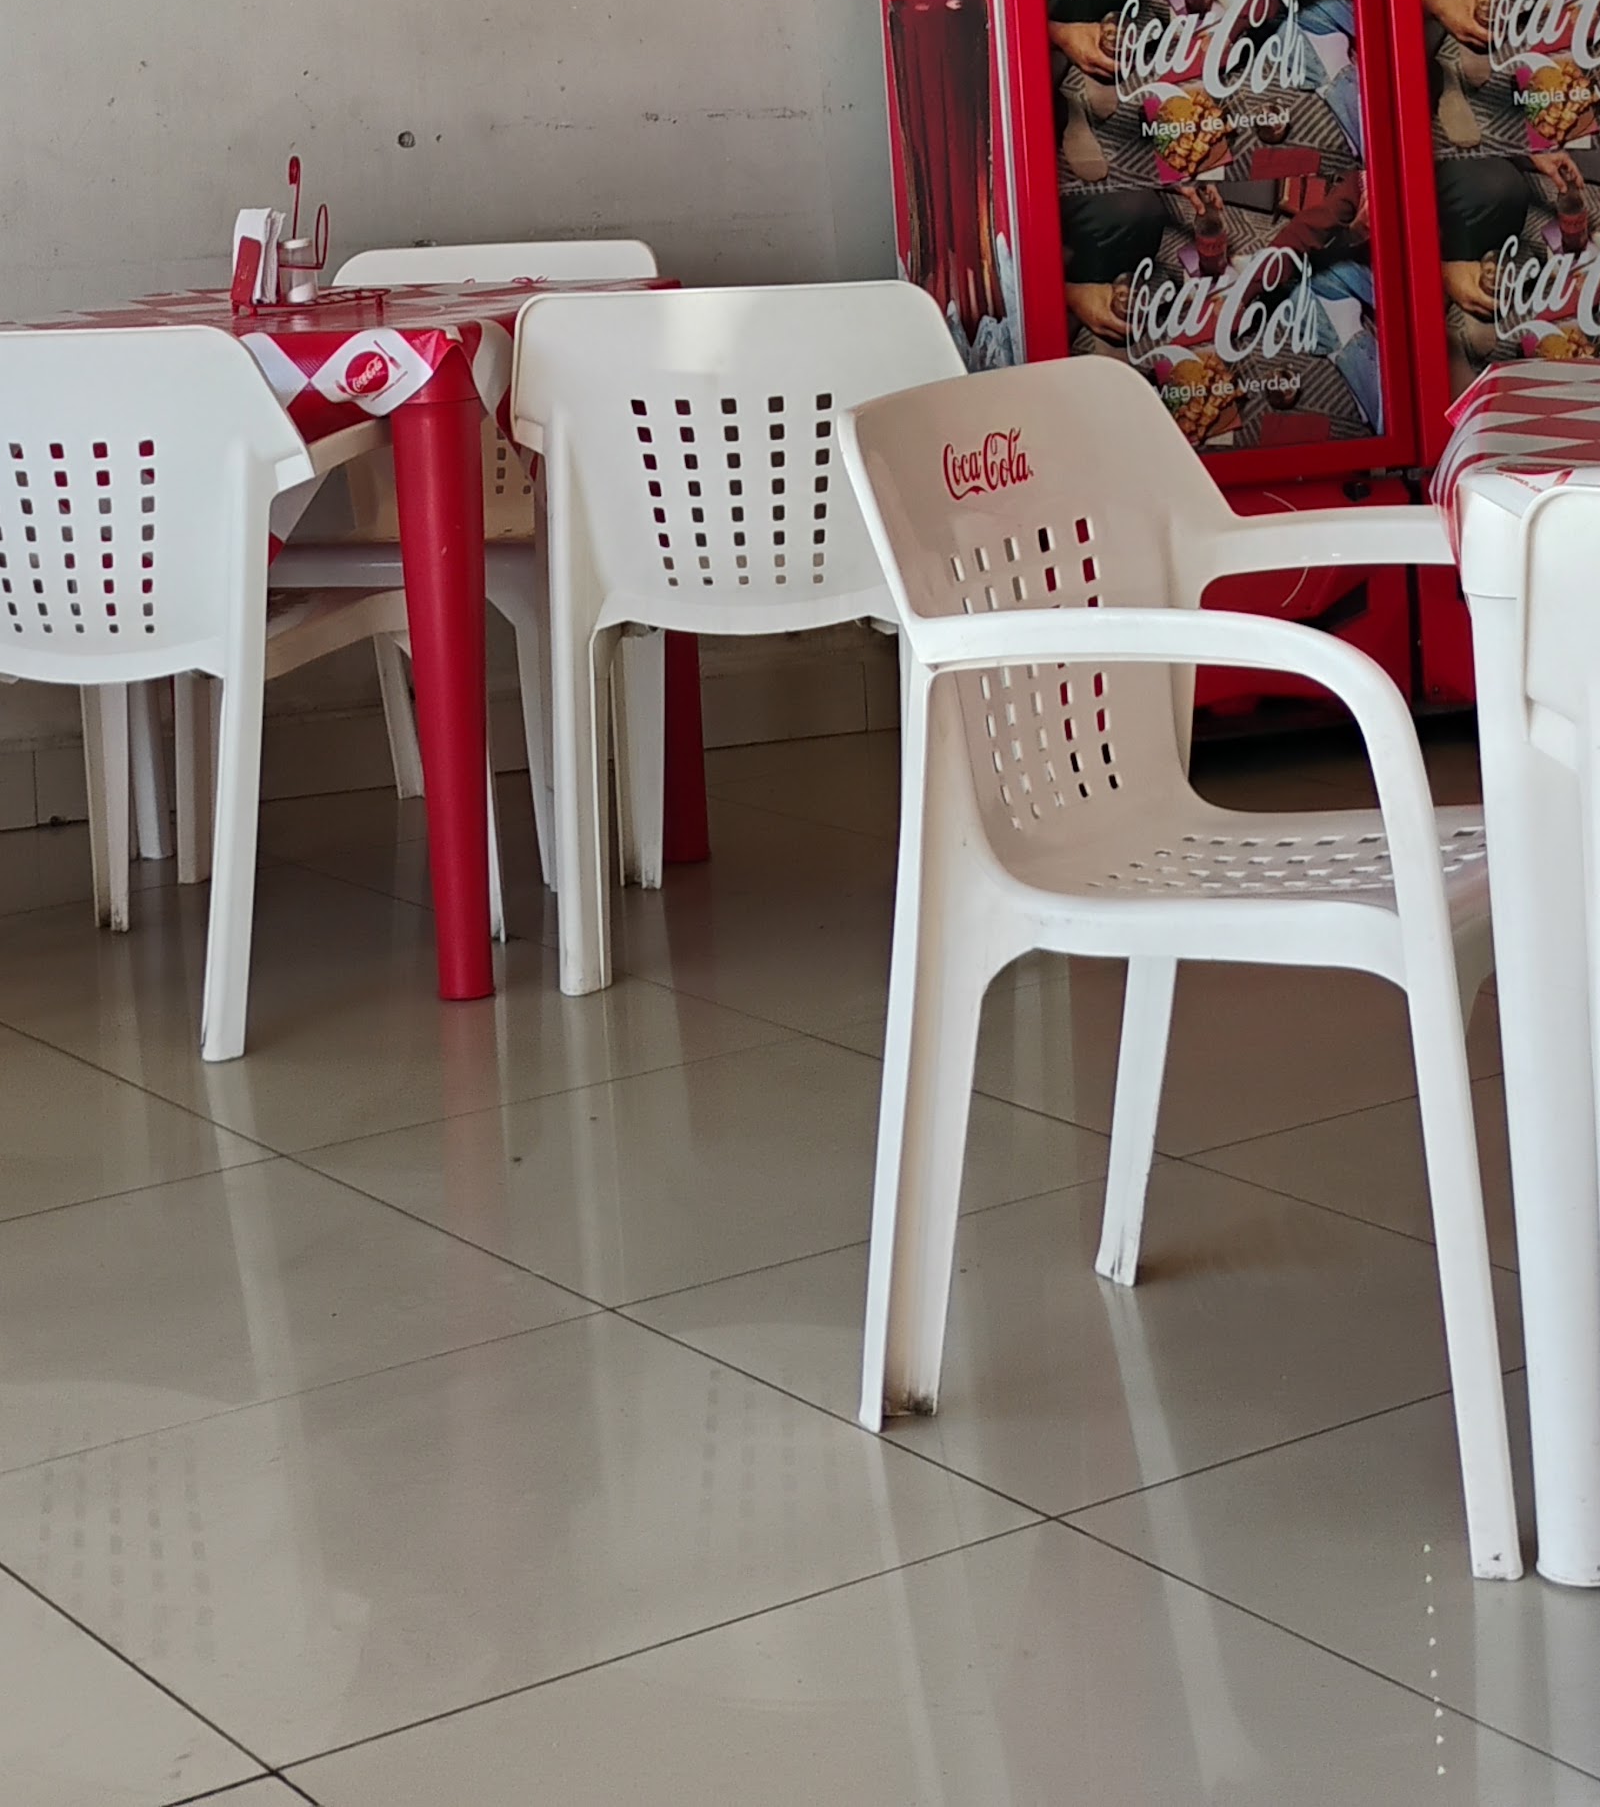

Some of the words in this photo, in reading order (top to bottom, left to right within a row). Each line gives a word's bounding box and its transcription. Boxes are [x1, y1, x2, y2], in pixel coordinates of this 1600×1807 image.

[1513, 87, 1565, 106] Magia
[1568, 85, 1591, 102] de
[1141, 121, 1196, 138] Magia
[1200, 116, 1223, 131] de
[1227, 110, 1290, 128] Verdad
[1126, 246, 1319, 366] Coca-Cola
[352, 355, 384, 393] Coca-Cola
[1152, 382, 1207, 401] Magia
[1211, 380, 1234, 395] de
[1237, 374, 1301, 392] Verdad
[943, 427, 1033, 501] Coca-Cola
